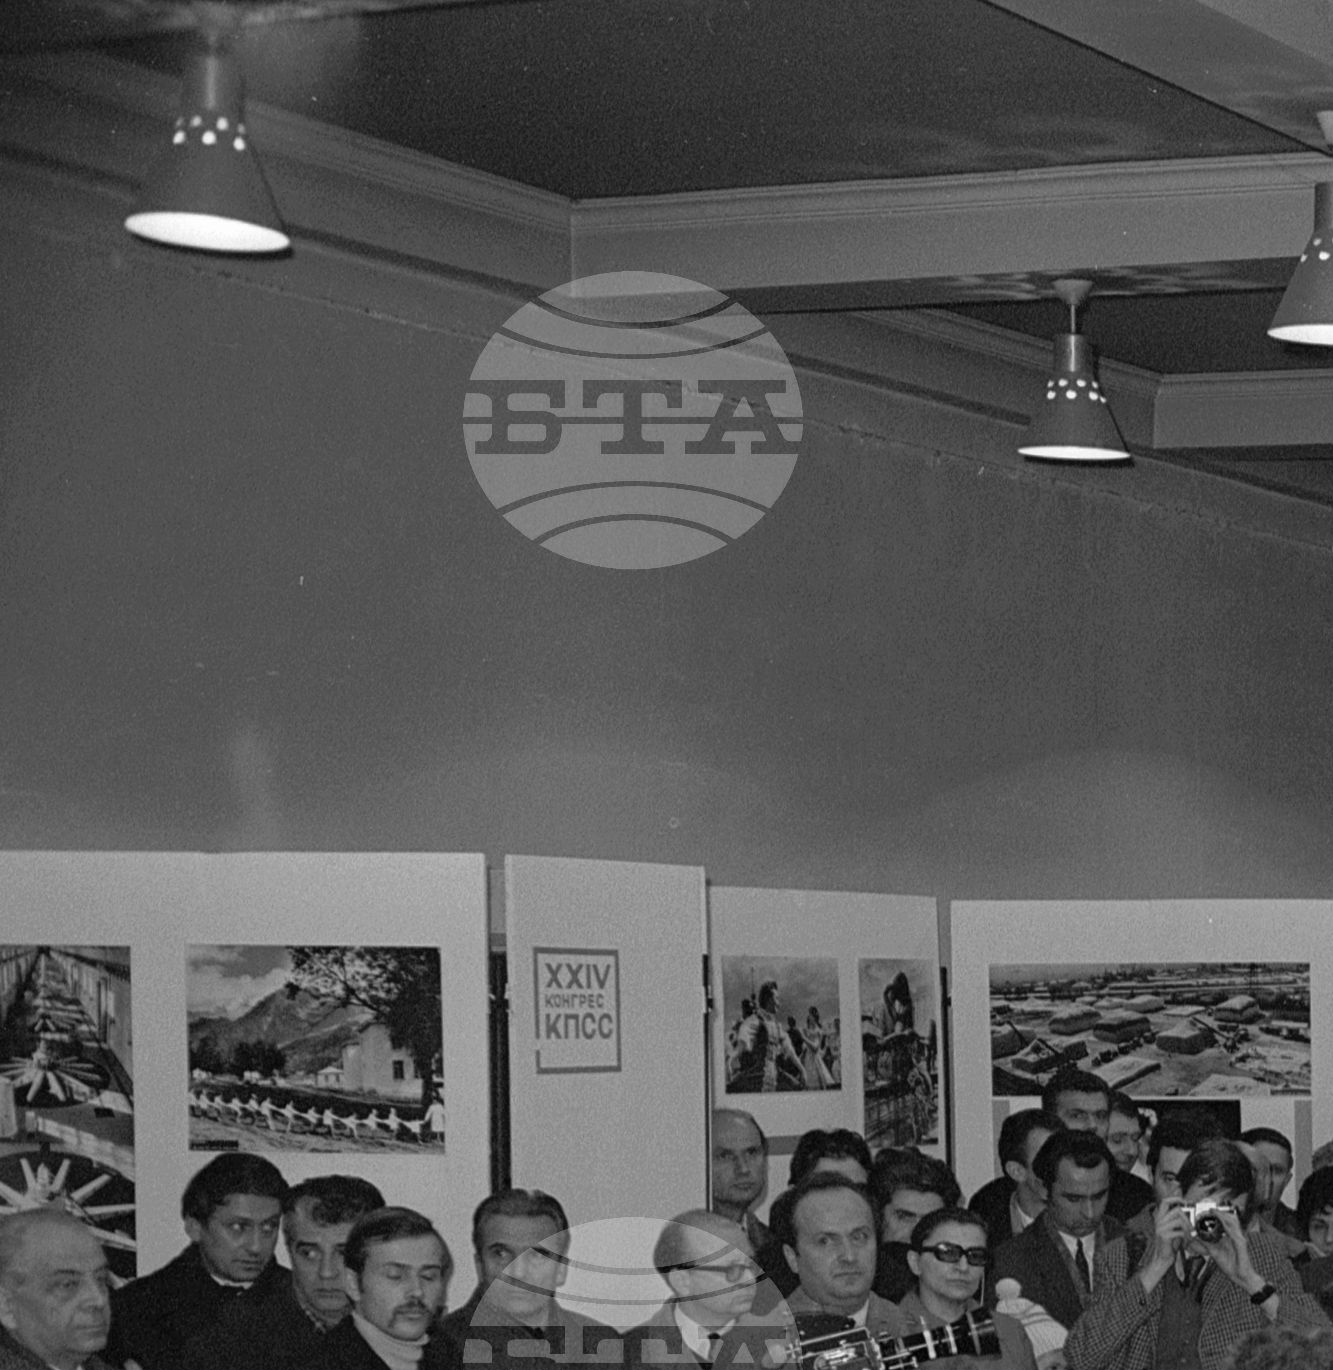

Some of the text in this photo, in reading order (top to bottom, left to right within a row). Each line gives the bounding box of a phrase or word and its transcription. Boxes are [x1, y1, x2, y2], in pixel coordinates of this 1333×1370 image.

[545, 963, 611, 989] XXIV
[545, 993, 604, 1008] КОНГРЕС
[545, 1013, 613, 1039] КПСС
